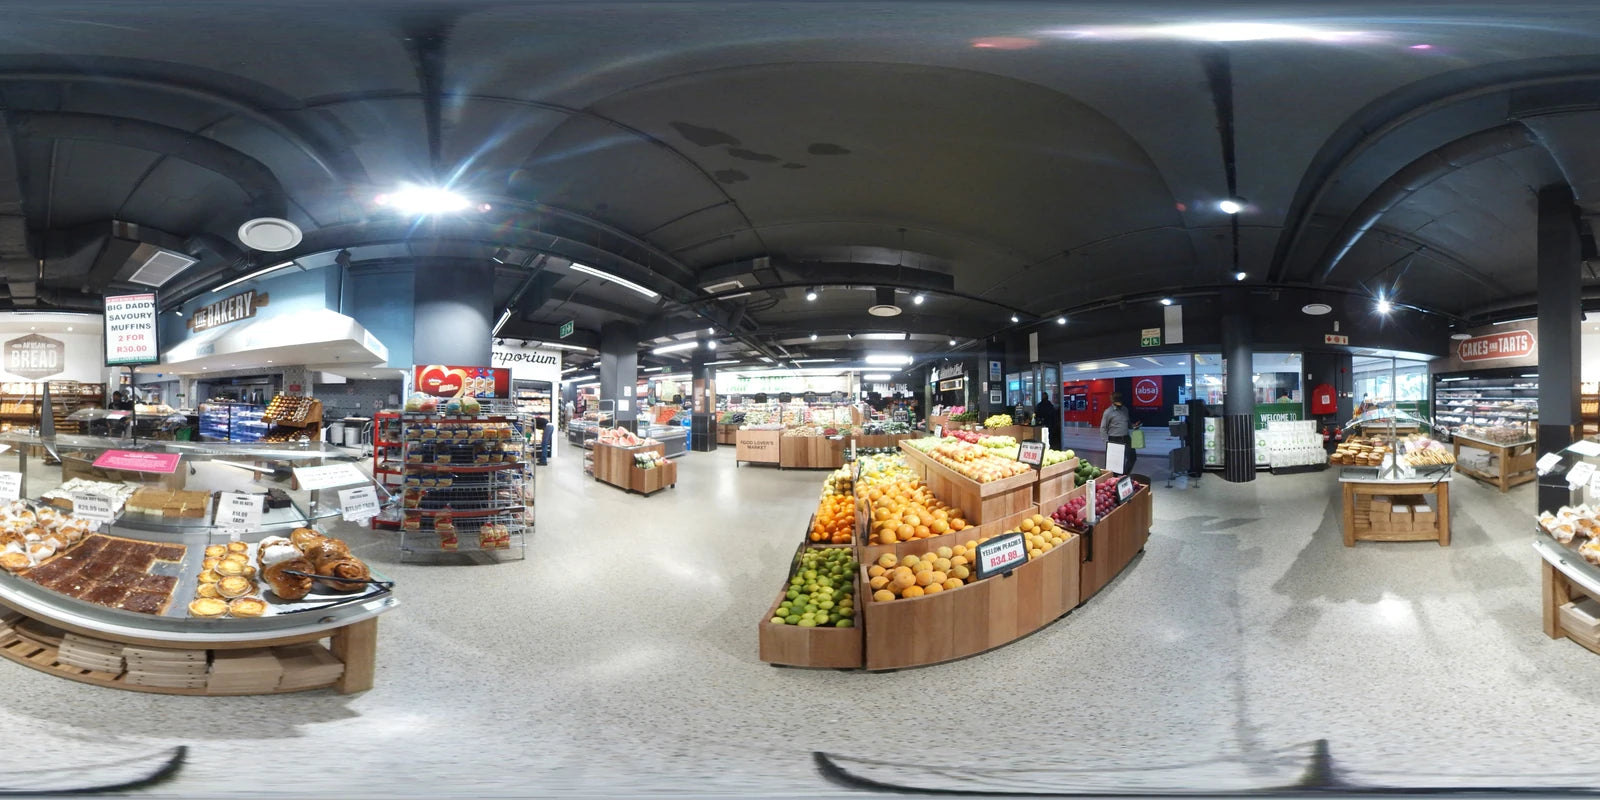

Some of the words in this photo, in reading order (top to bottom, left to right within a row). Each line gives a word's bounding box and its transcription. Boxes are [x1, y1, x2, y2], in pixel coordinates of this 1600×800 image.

[125, 302, 156, 310] DADDY
[195, 311, 206, 325] THE
[207, 291, 253, 328] BAKERY
[109, 312, 152, 321] SAVOURY
[111, 323, 151, 331] MUFFINS
[116, 345, 147, 353] R30.00
[1462, 340, 1488, 357] CAKES
[1498, 335, 1528, 353] TARTS
[11, 350, 57, 368] BREAD
[492, 351, 557, 366] mporium
[1138, 385, 1157, 394] absa
[1260, 413, 1289, 422] WELCOME
[1289, 412, 1297, 421] TO
[982, 545, 1002, 557] YELLOW
[1002, 538, 1022, 551] PEACHES
